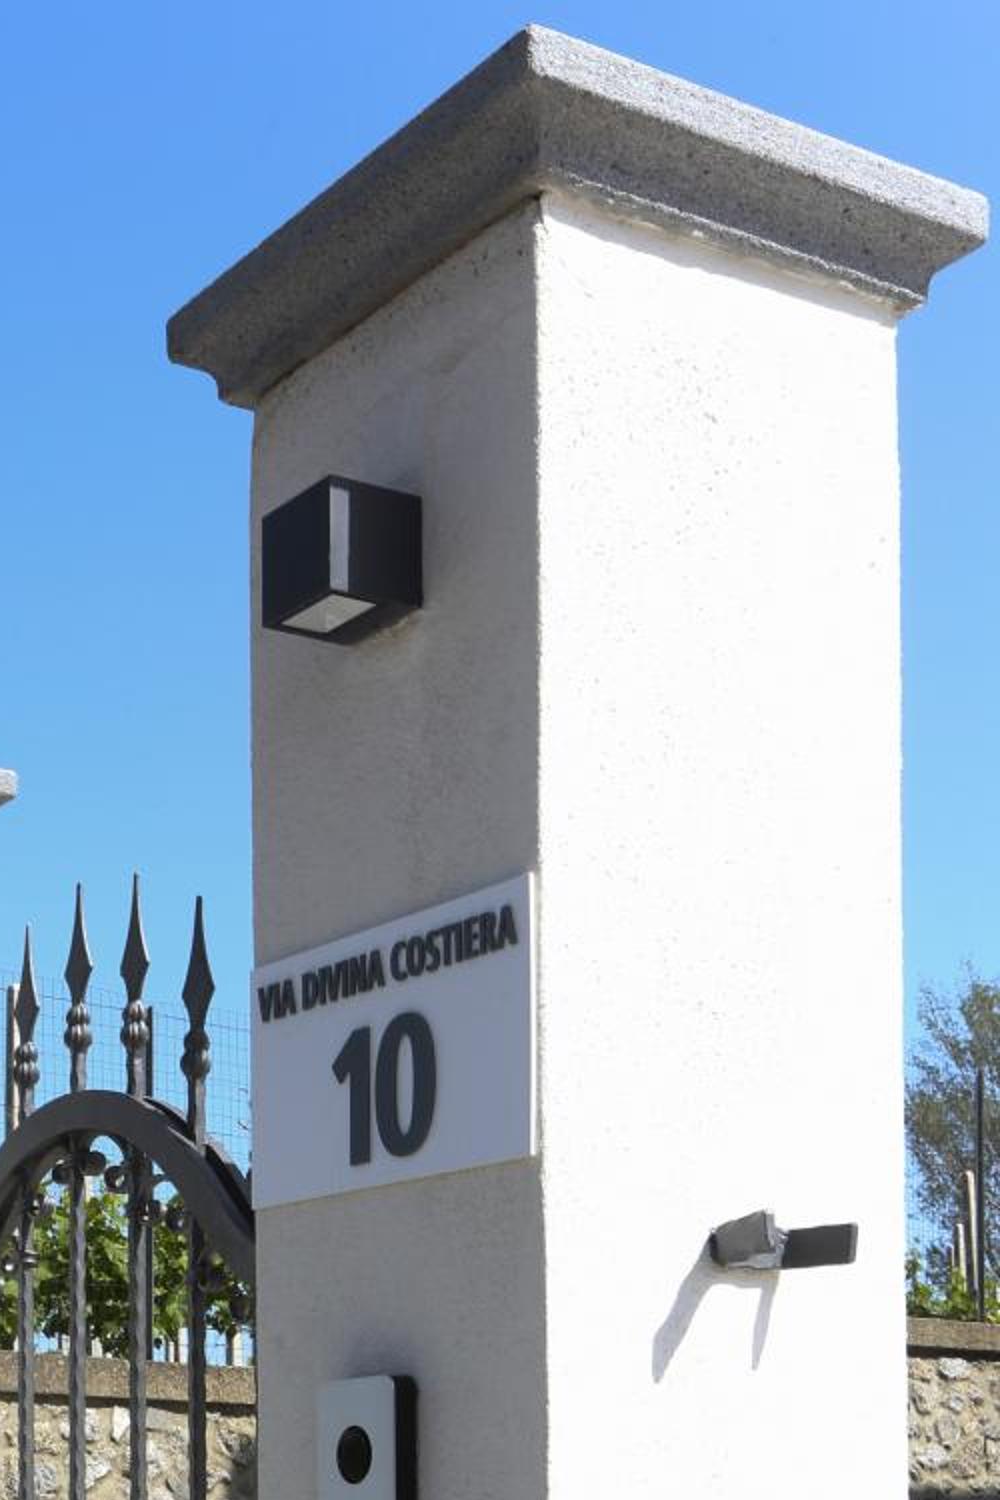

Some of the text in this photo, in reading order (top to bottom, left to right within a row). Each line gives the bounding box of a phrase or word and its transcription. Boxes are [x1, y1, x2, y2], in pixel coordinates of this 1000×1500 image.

[257, 903, 519, 1024] VIA DIVINA COSTIERA
[331, 1011, 437, 1167] 10
